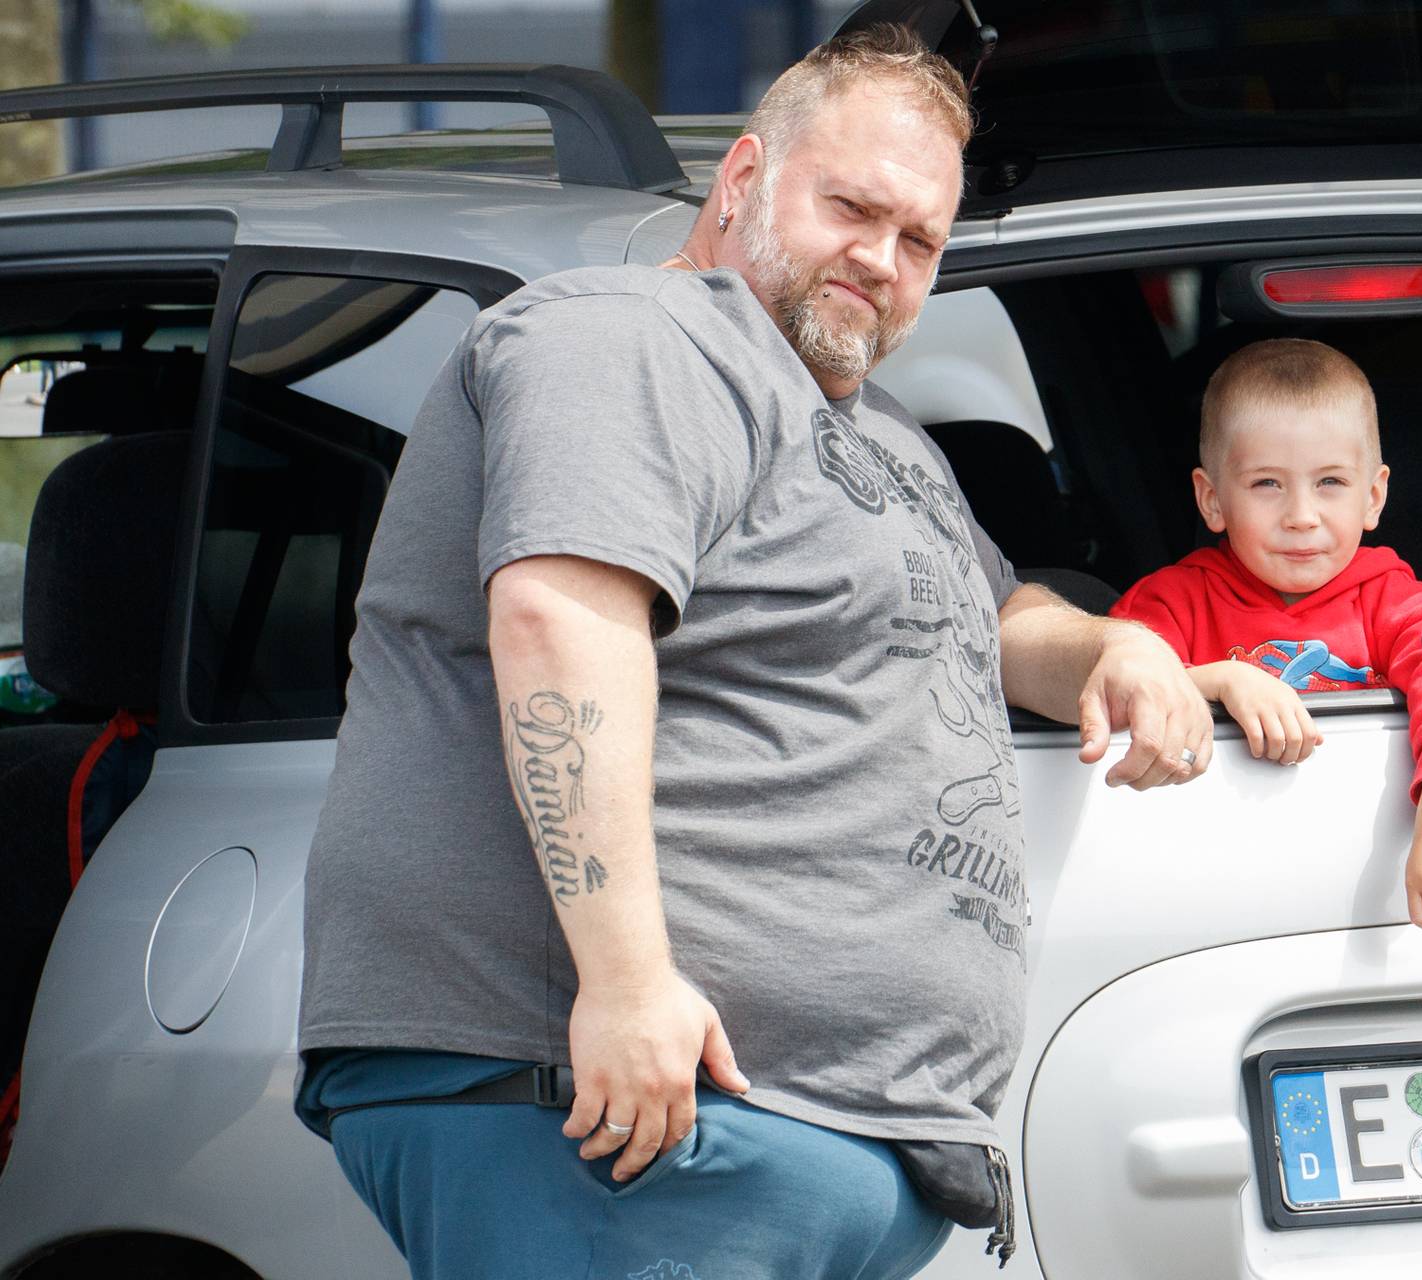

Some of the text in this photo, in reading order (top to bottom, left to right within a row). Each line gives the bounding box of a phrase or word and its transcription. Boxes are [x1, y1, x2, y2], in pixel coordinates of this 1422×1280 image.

[911, 577, 941, 606] BEER
[507, 690, 585, 909] Damian
[1338, 1083, 1405, 1183] E
[1299, 1152, 1321, 1181] D
